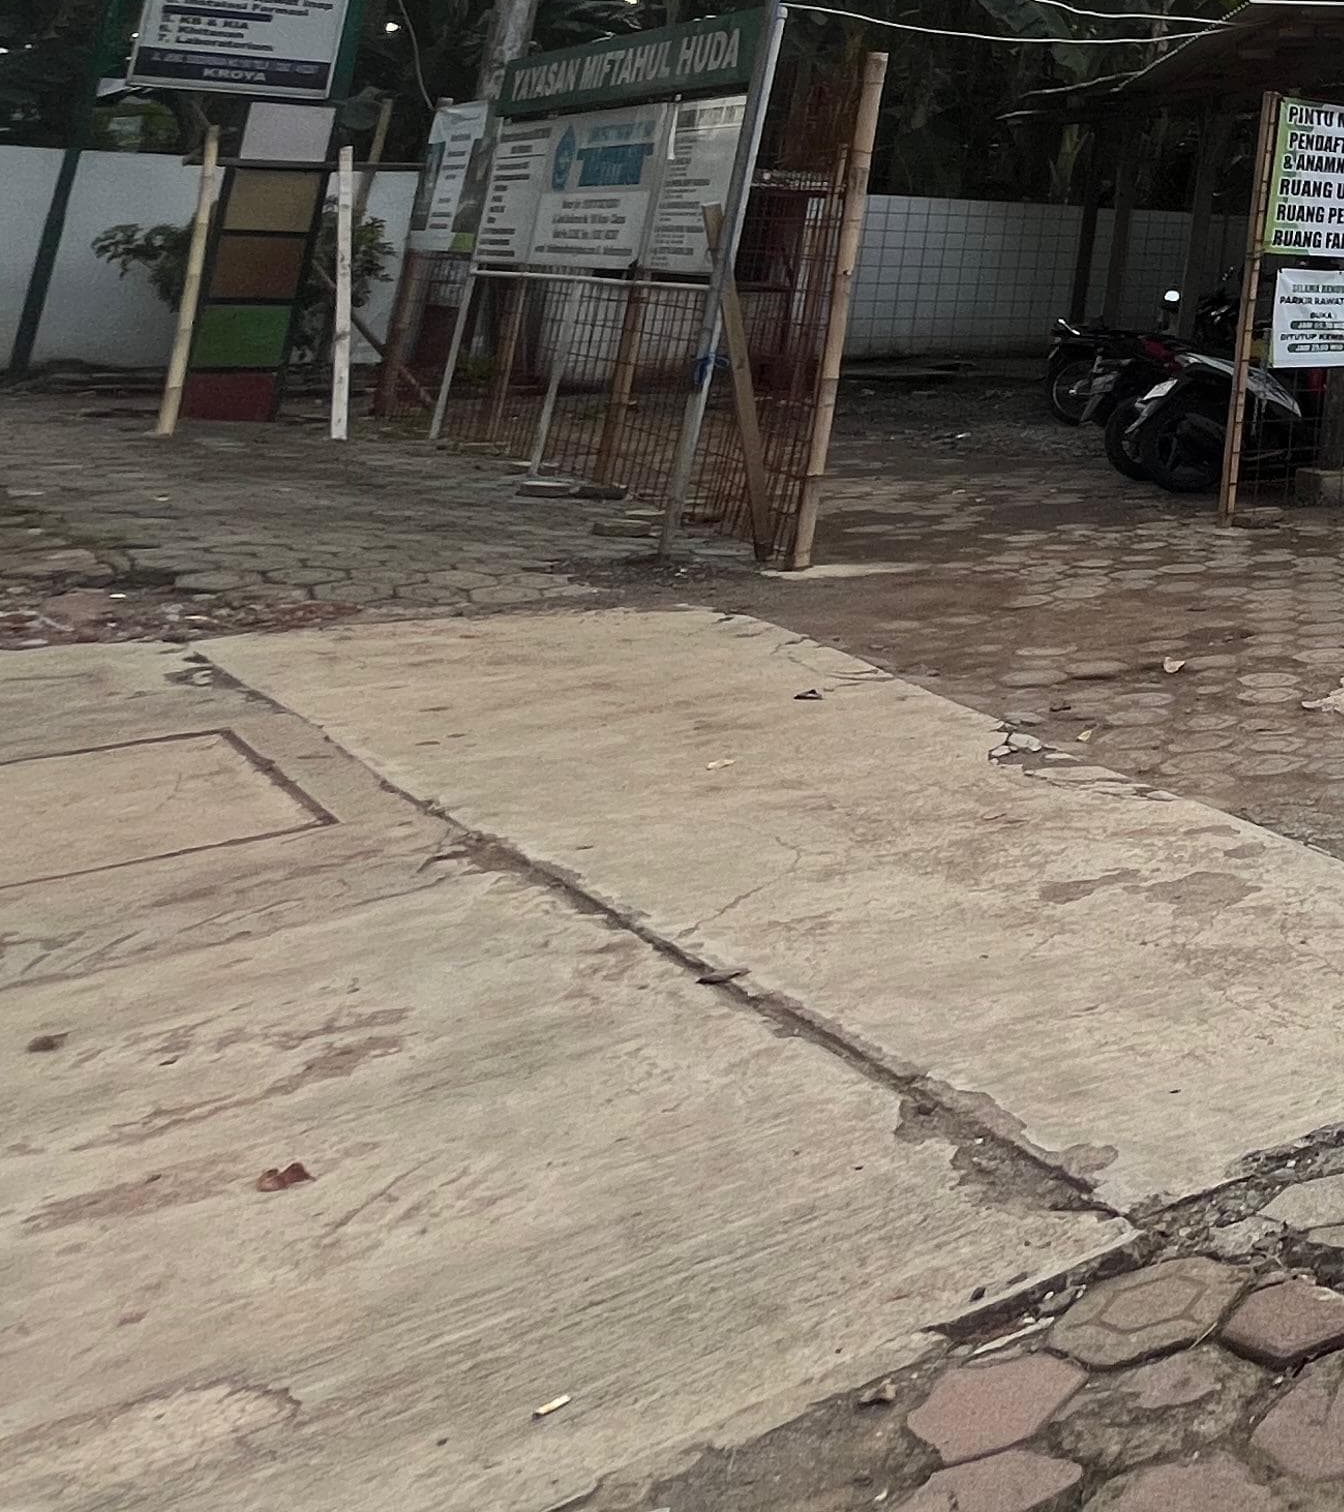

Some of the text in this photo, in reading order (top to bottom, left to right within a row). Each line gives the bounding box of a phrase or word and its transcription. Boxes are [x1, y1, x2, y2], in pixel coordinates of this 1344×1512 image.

[512, 28, 741, 102] YAYASAN MIFTAHUL HUDA
[202, 68, 267, 82] KROYA
[1288, 106, 1334, 127] PINTU
[1283, 155, 1293, 169] &
[1279, 178, 1333, 199] RUANG
[1276, 204, 1325, 223] RUANG
[1272, 229, 1322, 248] RUANG
[1280, 296, 1312, 305] PARKIR
[1314, 297, 1344, 305] RAWAT
